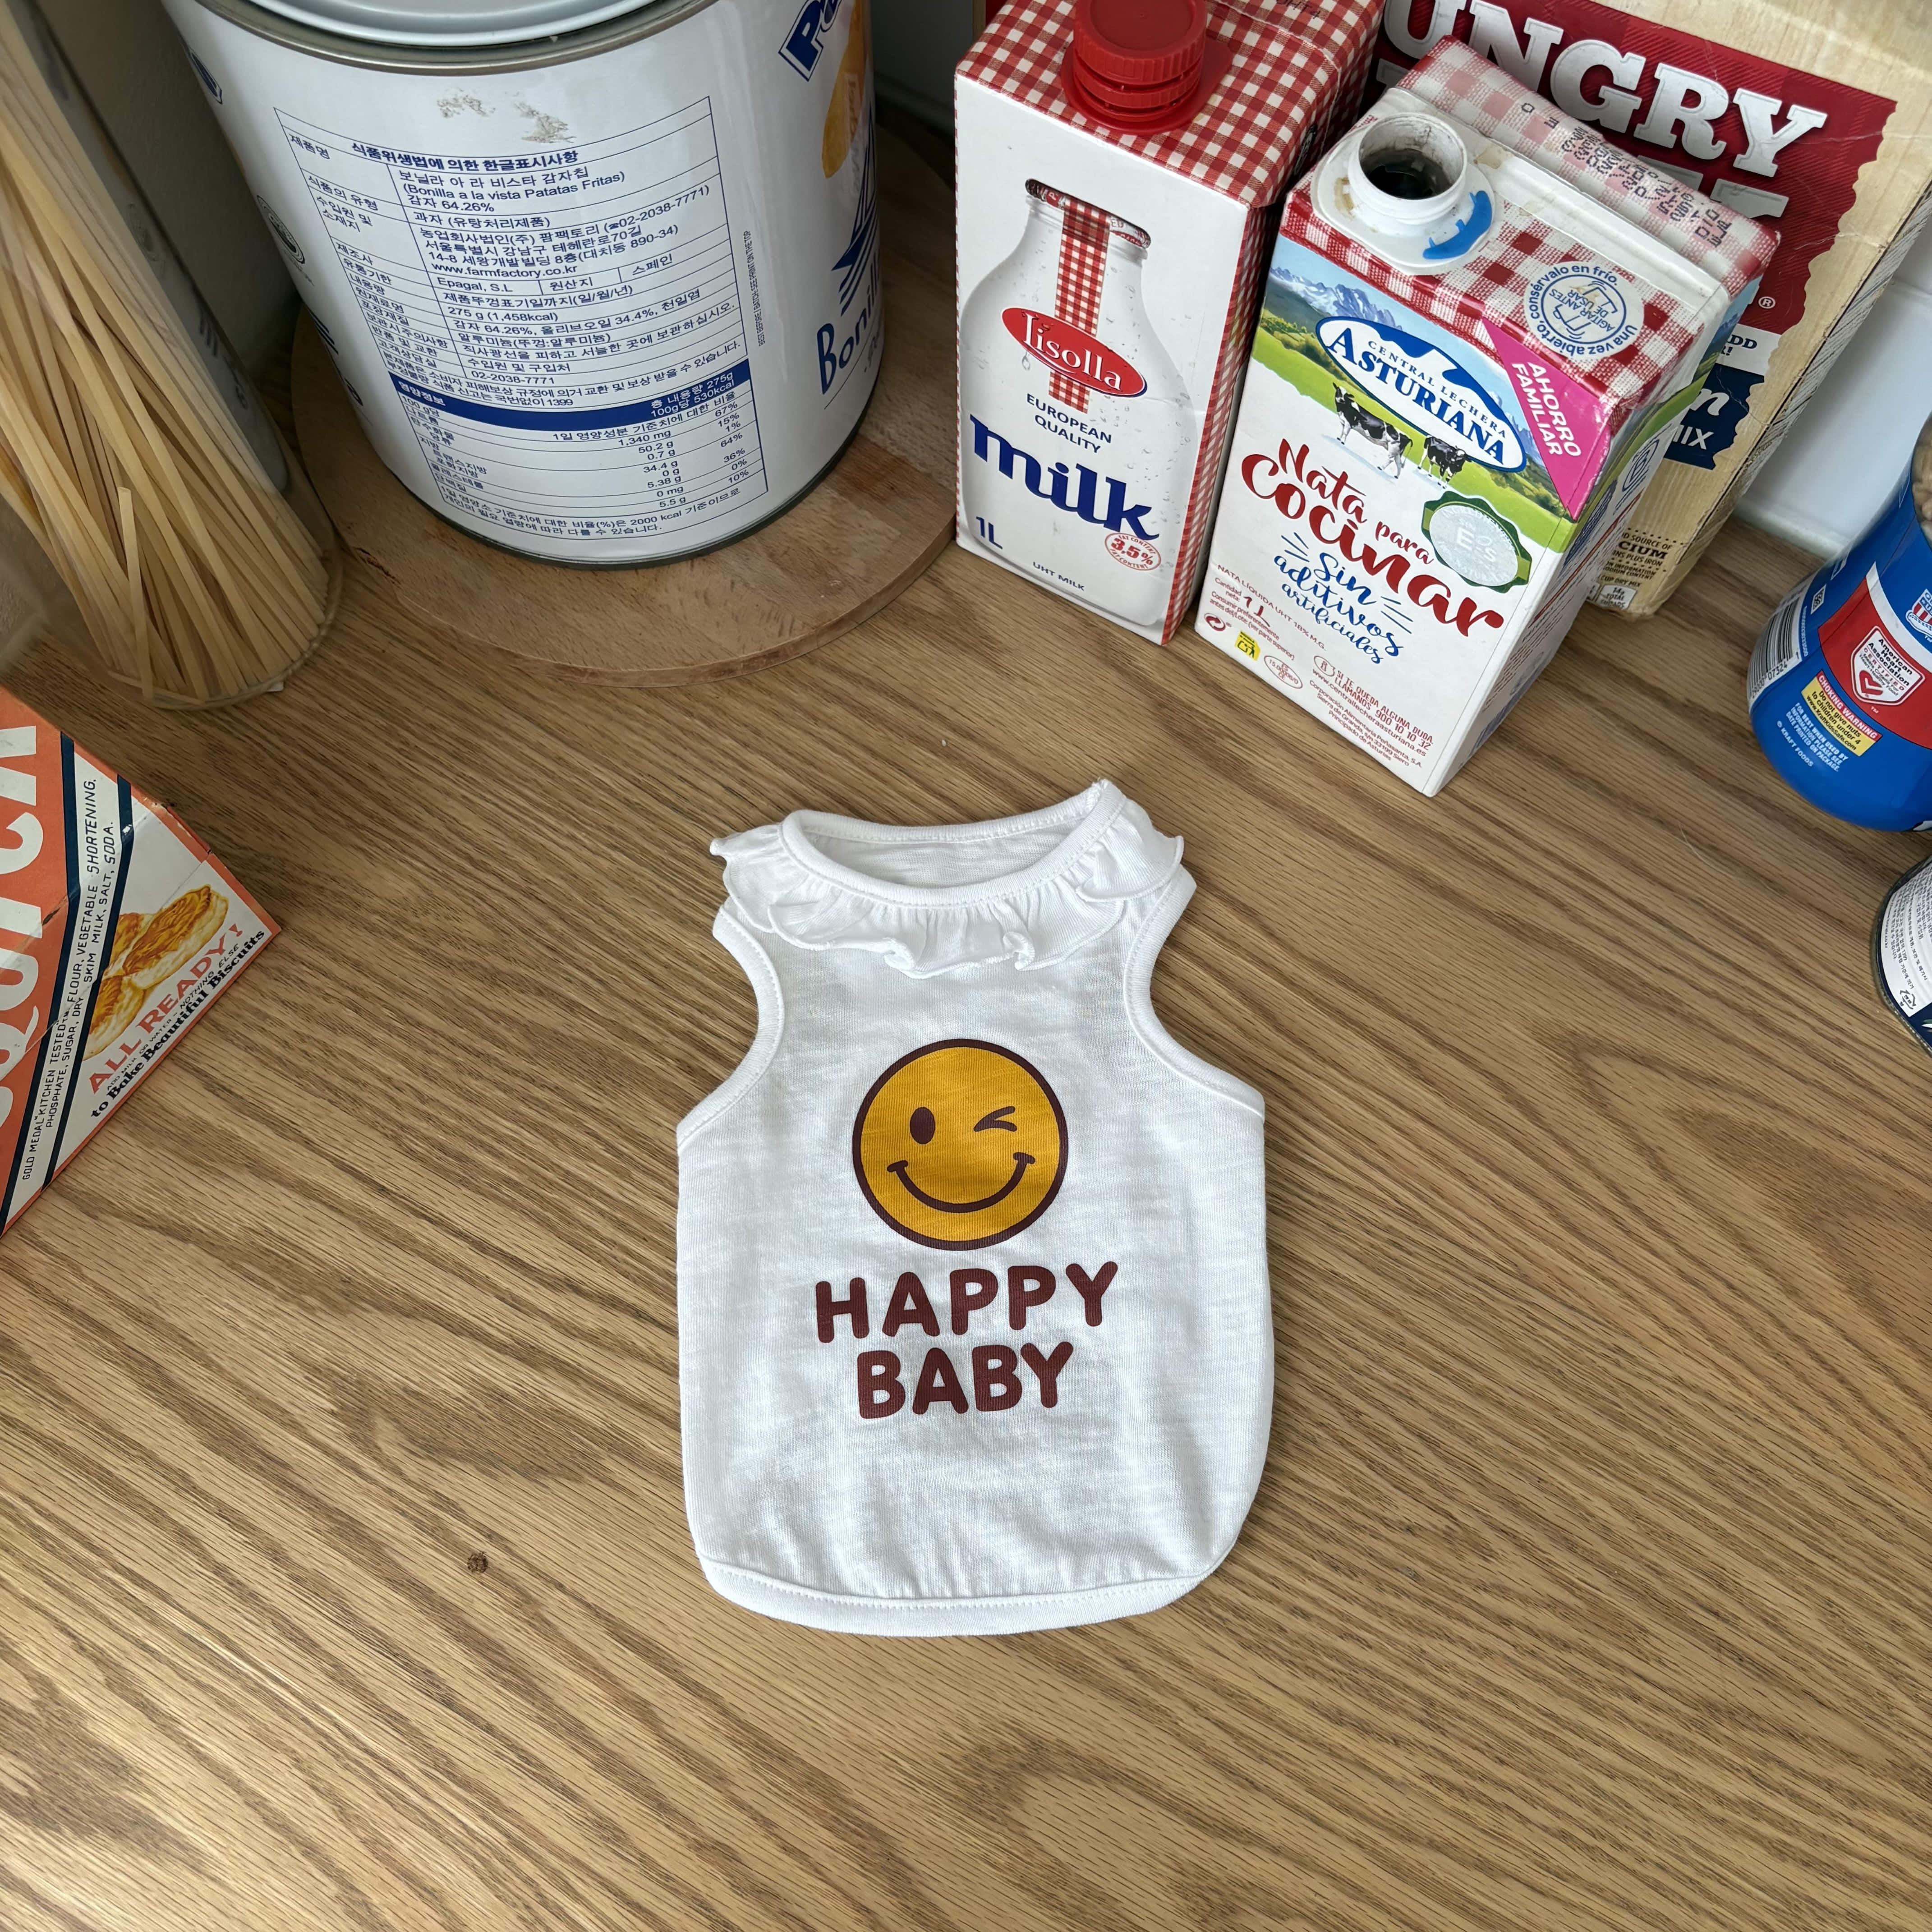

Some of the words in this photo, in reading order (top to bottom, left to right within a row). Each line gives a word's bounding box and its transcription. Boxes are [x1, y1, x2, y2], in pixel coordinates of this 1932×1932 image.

[1384, 0, 1828, 178] UNGRY
[289, 133, 330, 160] 제품명
[352, 143, 445, 171] 식품위생법에
[448, 158, 478, 171] 의한
[483, 150, 579, 171] 한글표시사항
[399, 170, 444, 187] 보닐라
[450, 174, 463, 188] 아
[469, 174, 483, 188] 라
[491, 172, 537, 188] 비스타
[543, 166, 589, 185] 감자칩
[404, 183, 455, 198] (Bonilla
[472, 189, 484, 199] la
[490, 189, 520, 199] vista
[526, 184, 578, 198] Patatas
[583, 171, 626, 190] Fritas)
[408, 194, 437, 208] 감자
[442, 200, 495, 212] 64.26%
[414, 212, 443, 225] 과자
[448, 216, 550, 229] (유탕처리제품)
[420, 228, 535, 245] 농업회사법인(주)
[540, 224, 599, 242] 팜팩토리
[425, 241, 498, 257] 서울특별시
[503, 245, 547, 257] 강남구
[552, 225, 642, 253] 테헤란로70길
[429, 253, 458, 264] 14-8
[462, 255, 550, 267] 세왕개발빌딩
[630, 225, 678, 249] 890-34)
[432, 263, 577, 278] www.farmfactory.co.kr
[632, 253, 673, 275] 스페인
[1571, 265, 1589, 273] en
[1593, 267, 1618, 285] frío.
[437, 277, 487, 291] Epagal,
[549, 277, 593, 291] 원산지
[1529, 267, 1569, 319] consérvalo
[1549, 289, 1581, 310] ANTES
[1567, 290, 1594, 309] USAR
[448, 307, 472, 317] 275
[488, 309, 559, 322] (1,458kcal)
[455, 320, 480, 331] 감자
[484, 324, 537, 337] 64.26%,
[542, 317, 611, 336] 올리브오일
[616, 308, 658, 326] 34.4%,
[662, 289, 700, 311] 천일염
[657, 303, 735, 340] 보관하십시오.
[817, 253, 880, 395] Bonill
[1580, 307, 1615, 332] AGITAR
[1594, 306, 1609, 318] DE
[1537, 321, 1585, 356] abierto,
[1588, 343, 1614, 354] vez
[1613, 325, 1638, 345] Una
[471, 370, 555, 385] 02-2038-7771
[694, 381, 734, 405] 530kcal
[707, 371, 734, 391] 275g
[1368, 339, 1435, 387] CENTRAL
[1440, 385, 1507, 438] LECHERA
[714, 402, 738, 418] 67%
[1329, 327, 1505, 465] ASTURIANA
[1512, 362, 1563, 455] FAMILIAR
[1529, 362, 1581, 457] AHORRO
[1026, 394, 1112, 444] EUROPEAN
[1035, 415, 1101, 453] QUALITY
[638, 442, 665, 455] 50.2
[720, 432, 743, 448] 64%
[723, 448, 745, 463] 36%
[643, 461, 668, 474] 34.4
[647, 478, 672, 489] 5.38
[727, 469, 750, 484] 10%
[970, 414, 1159, 540] milk
[1279, 438, 1368, 524] Nata
[1375, 521, 1435, 565] para
[976, 516, 1003, 549] 1L
[1242, 454, 1504, 637] Cocinar
[1618, 541, 1668, 559] CIUM
[1631, 534, 1661, 548] SOURCE
[1032, 561, 1055, 577] UHT
[1059, 574, 1085, 590] MILK
[1313, 552, 1377, 607] Sin
[1645, 558, 1663, 567] IRON
[1215, 577, 1242, 596] Cantidad
[1218, 564, 1241, 582] NATA
[1242, 580, 1274, 610] LÍQUIDA
[1276, 607, 1292, 622] UHT
[1211, 591, 1237, 611] Consumir
[1237, 607, 1280, 641] preferentemente
[1274, 555, 1404, 657] aditivos
[1281, 583, 1384, 664] artificiales
[1767, 660, 1788, 681] 07324
[1863, 647, 1905, 691] CERTIFIED
[1868, 642, 1910, 687] Association
[1878, 639, 1913, 676] American
[1881, 649, 1902, 673] Heart
[1309, 680, 1344, 711] Corporación
[1345, 708, 1376, 736] Alimentaria
[1312, 668, 1427, 757] www.centrallecheraasturiana.es
[1356, 686, 1379, 708] QUEDA
[1381, 705, 1410, 730] ALGUNA
[1412, 727, 1434, 745] DUDA.
[1806, 695, 1857, 751] www.KraftKidsSafe.com
[1817, 698, 1838, 725] children
[1836, 723, 1855, 741] under
[1818, 675, 1843, 709] CHOKING
[1842, 707, 1878, 740] WARNING
[1818, 690, 1826, 699] Do
[1825, 699, 1835, 713] not
[1833, 710, 1848, 726] give
[1846, 723, 1862, 738] nuts
[1375, 710, 1392, 726] 900
[1394, 723, 1403, 735] 10
[1407, 731, 1417, 742] 10
[1418, 739, 1431, 751] 32
[1790, 707, 1816, 742] INFORMATION
[1813, 738, 1832, 757] PLEASE
[1802, 712, 1814, 728] BEST
[1812, 726, 1827, 743] WHEN
[1826, 741, 1840, 755] USED
[1794, 746, 1814, 767] FOODS
[1815, 750, 1840, 773] PACKAGE.
[86, 778, 100, 874] SHORTENING,
[104, 820, 115, 865] SODA.
[100, 869, 115, 905] SALT,
[77, 884, 98, 955] VEGETABLE
[92, 907, 108, 943] MILK,
[68, 953, 87, 1004] FLOUR,
[84, 952, 97, 983] SKIM
[72, 997, 84, 1018] DRY
[89, 1039, 142, 1094] ALL
[135, 923, 244, 1034] READY!
[91, 1100, 109, 1118] to
[106, 1061, 145, 1099] Bake
[142, 989, 210, 1063] Beautiful
[207, 930, 265, 990] Biscuits
[107, 1075, 120, 1090] ADD
[121, 1057, 138, 1074] MILK
[149, 1019, 172, 1043] WATER
[179, 971, 215, 1009] NOTHING
[218, 943, 239, 968] ELSE
[62, 1021, 79, 1063] SUGAR,
[46, 1065, 68, 1127] PHOSPHATE,
[30, 1120, 44, 1152] MEDAL
[23, 1156, 35, 1180] GOLD
[816, 1261, 1118, 1343] HAPPY
[858, 1341, 1073, 1419] BABY
